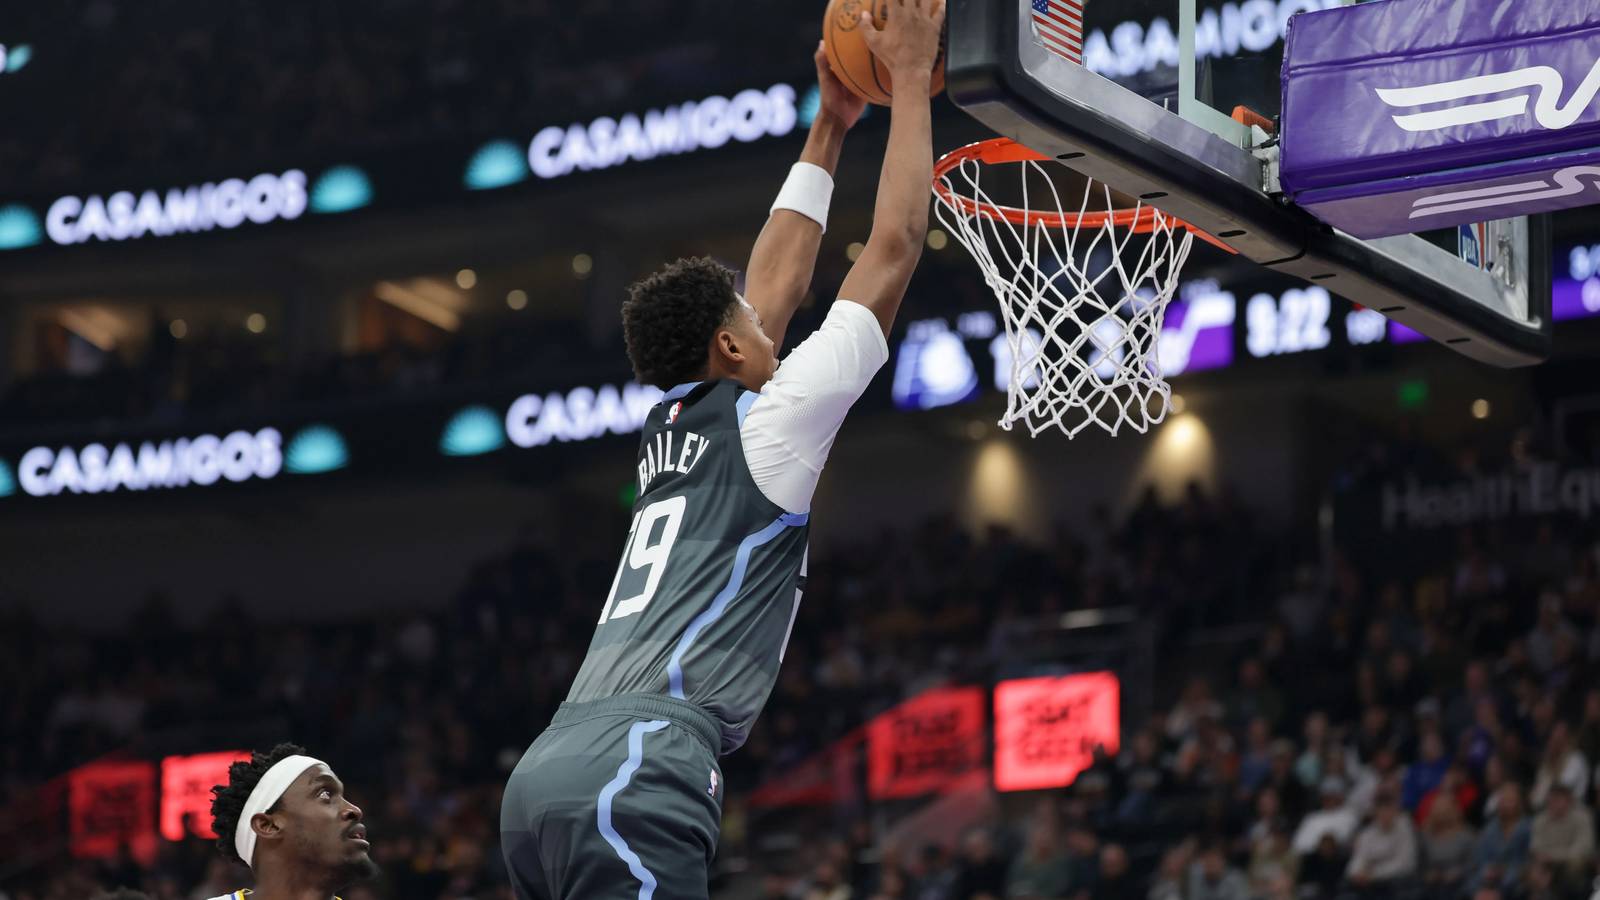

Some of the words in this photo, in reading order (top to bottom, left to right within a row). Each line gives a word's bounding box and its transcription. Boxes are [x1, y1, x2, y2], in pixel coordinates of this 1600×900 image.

[1083, 0, 1342, 77] ASAMIGO
[529, 83, 797, 179] CASAMIGOS
[46, 169, 307, 245] CASAMIGOS
[506, 381, 665, 448] CASAM
[18, 427, 282, 496] CASAMIGOS
[638, 430, 710, 497] BAILEY
[1383, 463, 1600, 531] HealthEq
[597, 495, 687, 625] 19
